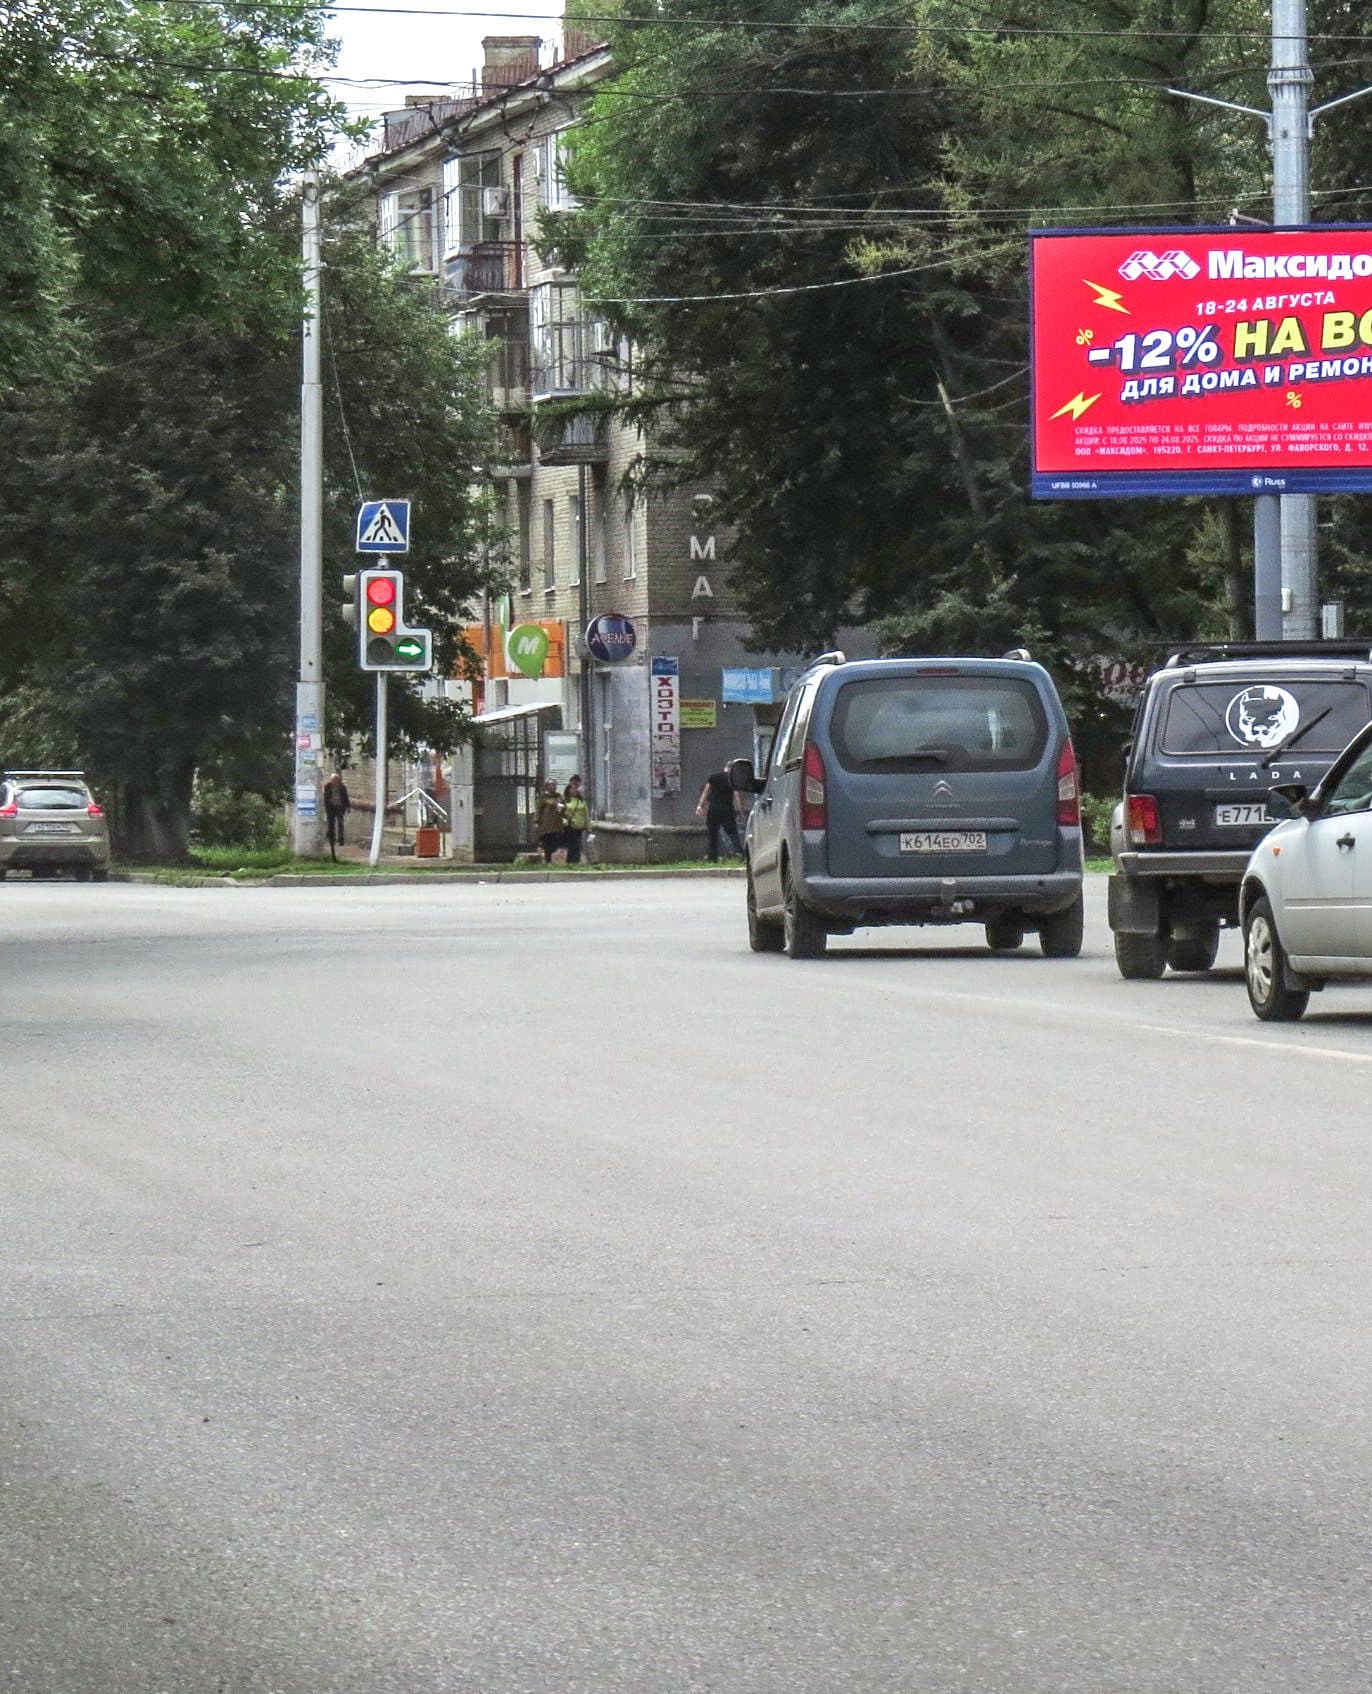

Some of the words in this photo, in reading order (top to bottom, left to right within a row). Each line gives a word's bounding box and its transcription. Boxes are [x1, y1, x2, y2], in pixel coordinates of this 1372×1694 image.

[1196, 298, 1248, 316] 18-24
[1252, 290, 1336, 311] АВГУСТА
[1087, 324, 1219, 371] -12%
[1234, 316, 1306, 358] НА
[1120, 376, 1175, 401] ДЛЯ
[1181, 368, 1257, 395] ДОМА
[1264, 366, 1281, 384] И
[1174, 424, 1184, 433] НА
[1188, 424, 1200, 433] ВСЕ
[1320, 422, 1330, 431] НА
[1075, 446, 1092, 454] ООО
[1229, 770, 1302, 781] LADA
[1221, 806, 1275, 823] Е771
[904, 833, 960, 849] К614ЕО
[961, 832, 984, 845] 702
